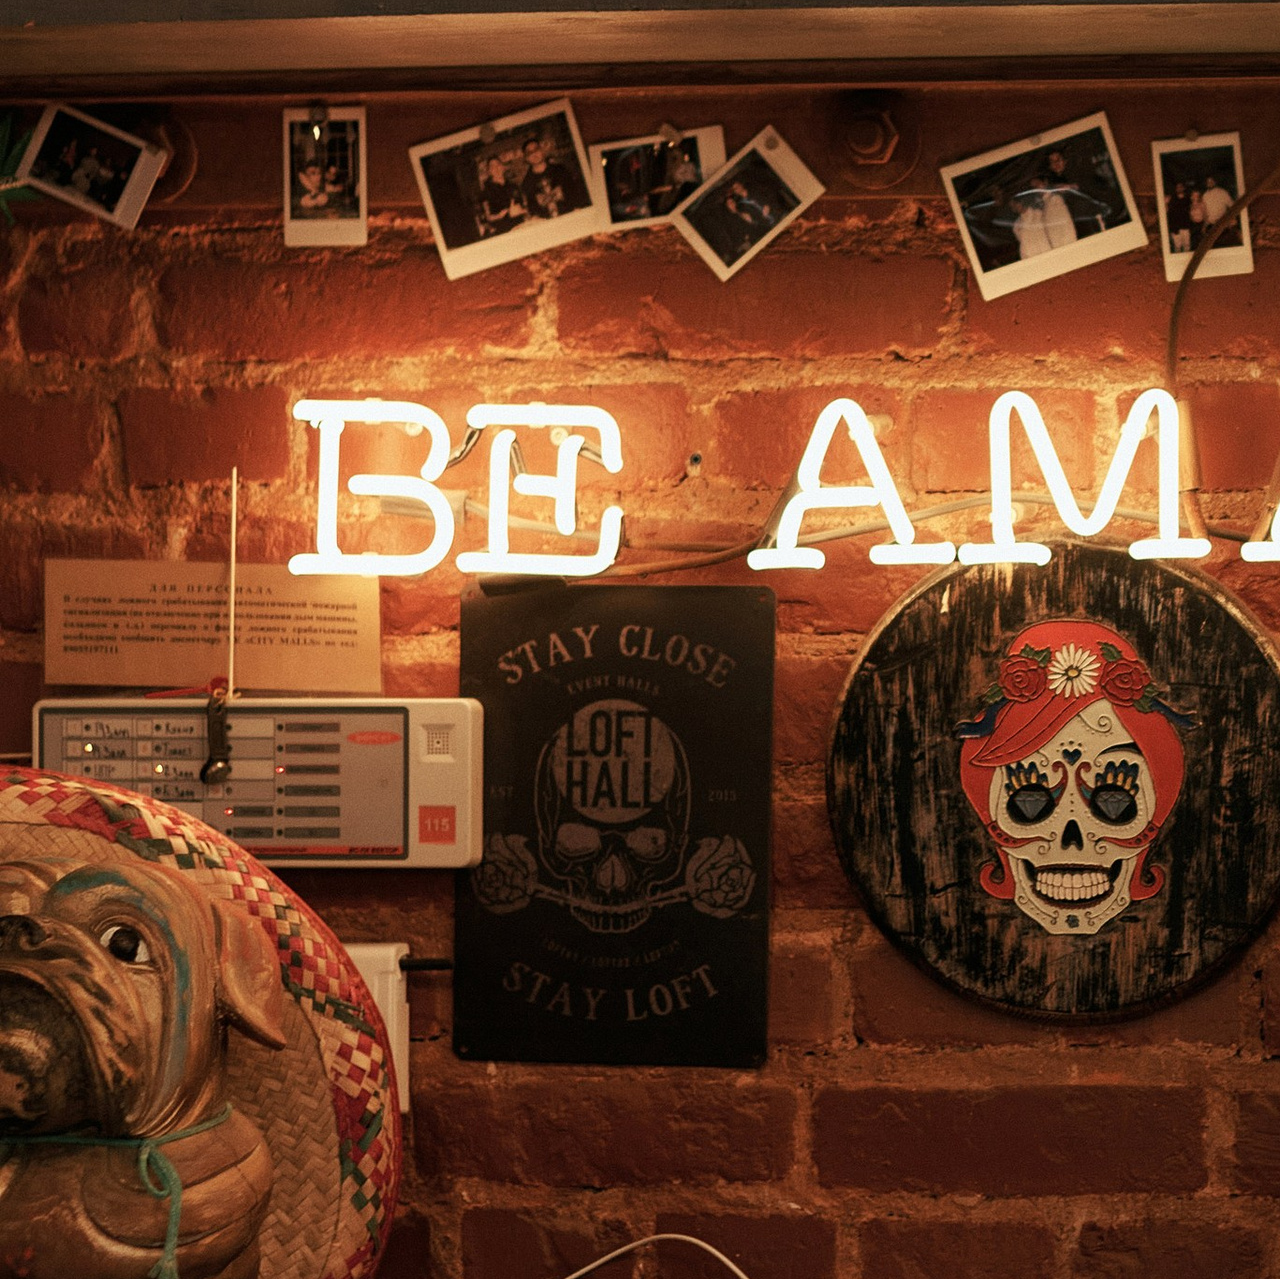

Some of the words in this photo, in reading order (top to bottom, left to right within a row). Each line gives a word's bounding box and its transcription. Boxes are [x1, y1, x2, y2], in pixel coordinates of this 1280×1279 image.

[287, 398, 625, 578] BE
[497, 624, 600, 685] STAY
[619, 625, 738, 689] CLOSE
[566, 675, 611, 696] EVENT
[617, 675, 660, 696] HALLS
[566, 710, 655, 757] LOFT
[566, 760, 663, 808] HALL
[424, 818, 450, 832] 115
[502, 961, 608, 1021] STAY
[624, 963, 720, 1022] LOFT
